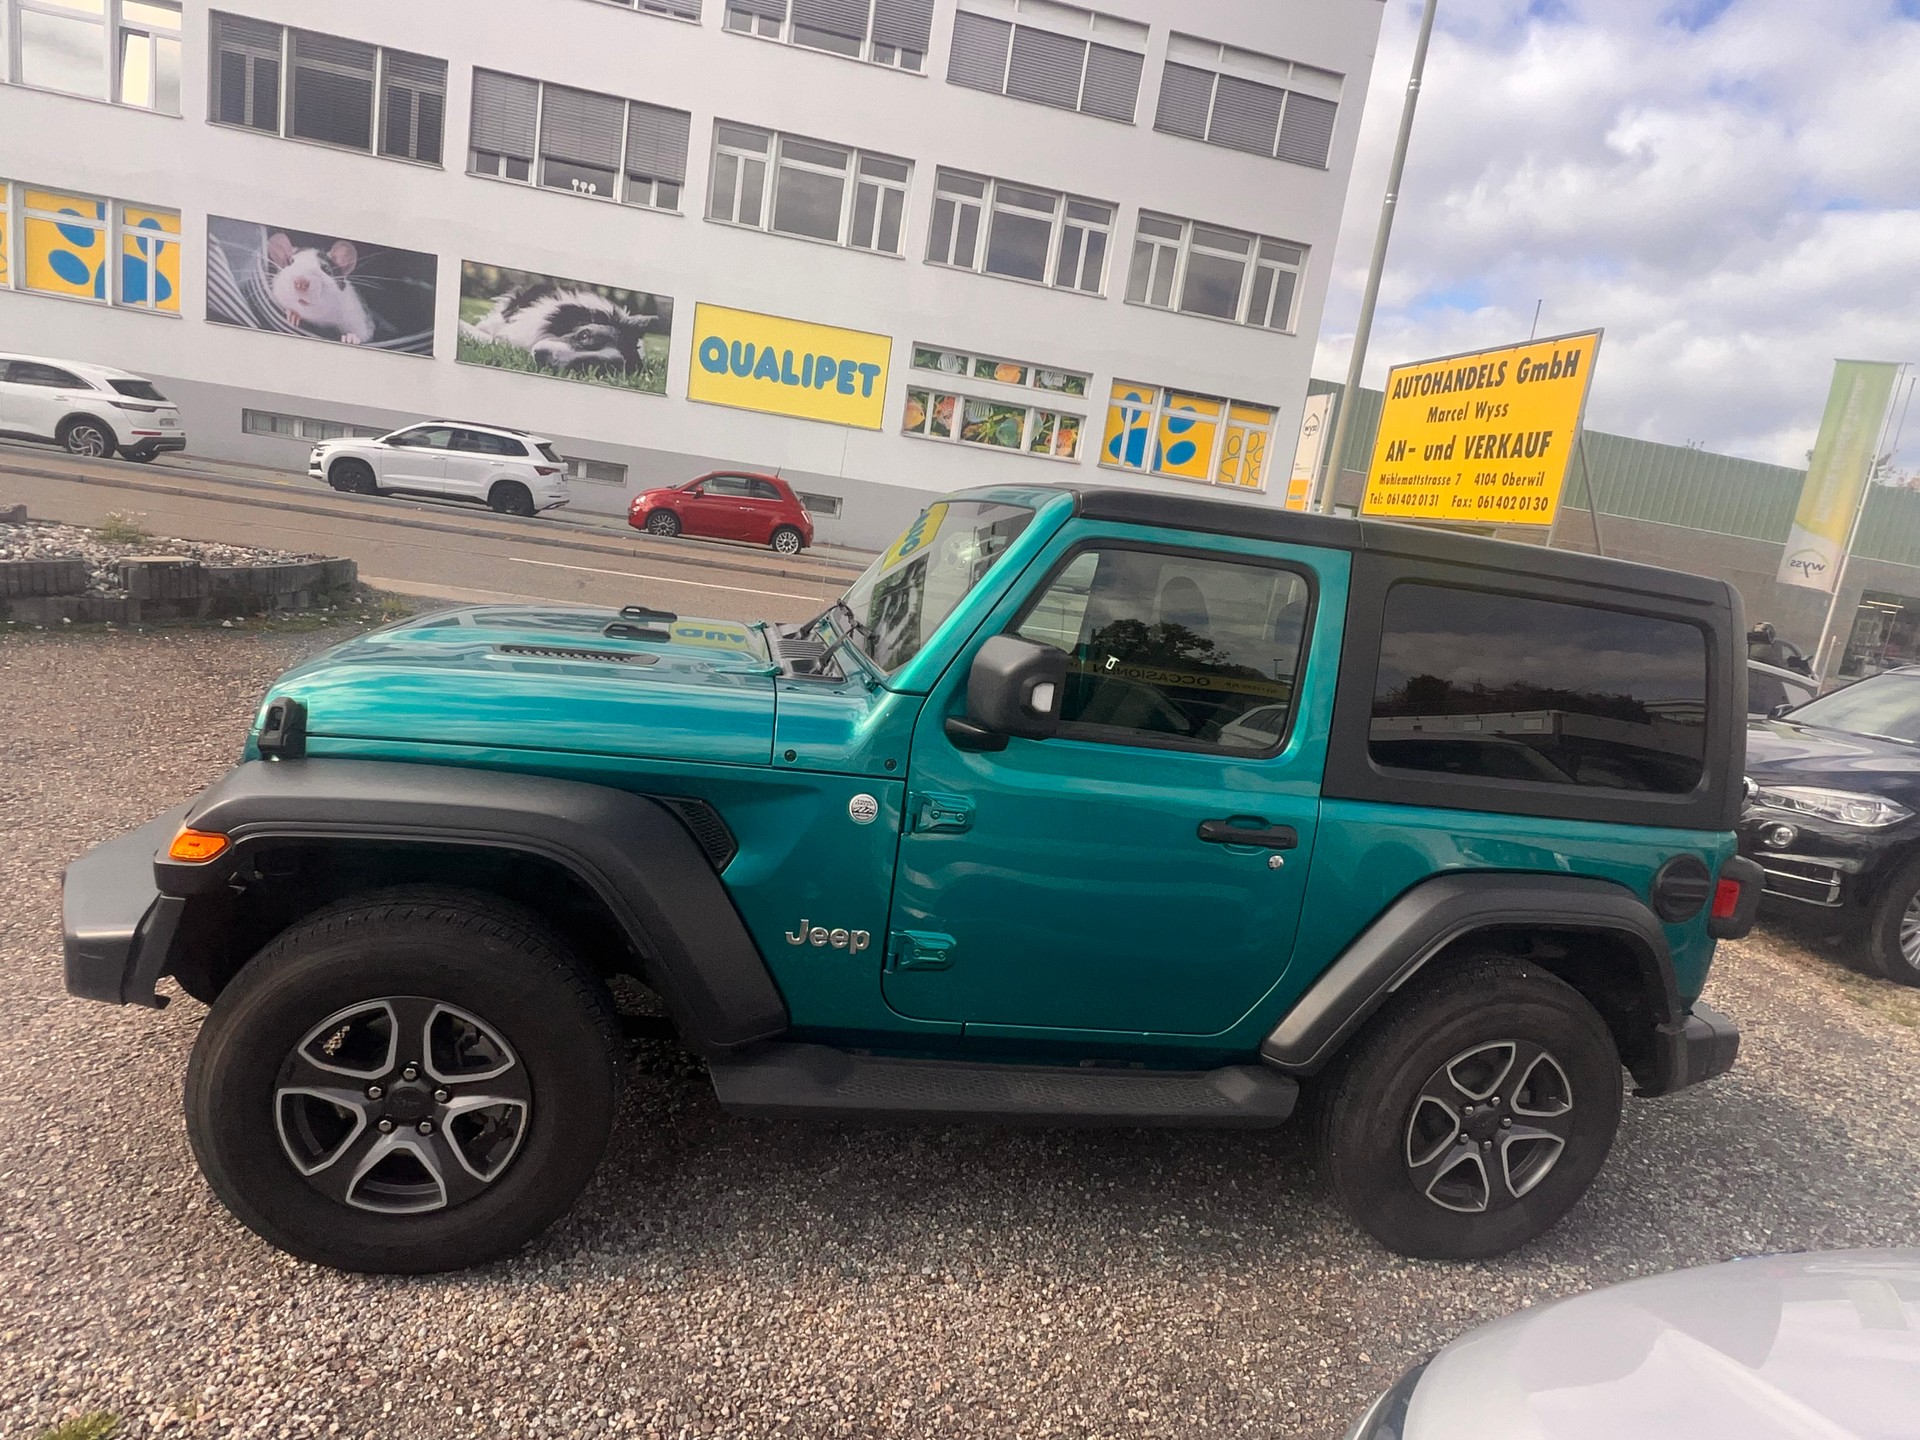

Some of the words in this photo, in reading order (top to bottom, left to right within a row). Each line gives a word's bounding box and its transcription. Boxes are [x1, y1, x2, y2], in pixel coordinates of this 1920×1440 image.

[699, 336, 881, 398] QUALIPET
[1392, 361, 1508, 400] AUTOHANDELS
[1516, 350, 1581, 384] GmbH
[1426, 401, 1470, 423] Marcel
[1474, 400, 1509, 422] Wyss
[1385, 439, 1416, 462] AN-
[1423, 434, 1456, 461] und
[1464, 431, 1553, 459] VERKAUF
[1455, 473, 1462, 486] 7
[1474, 473, 1497, 486] 4104
[1502, 471, 1545, 487] Oberwil
[1370, 492, 1384, 505] Tel:
[1452, 494, 1472, 508] Fax:
[785, 918, 870, 954] Jeep
